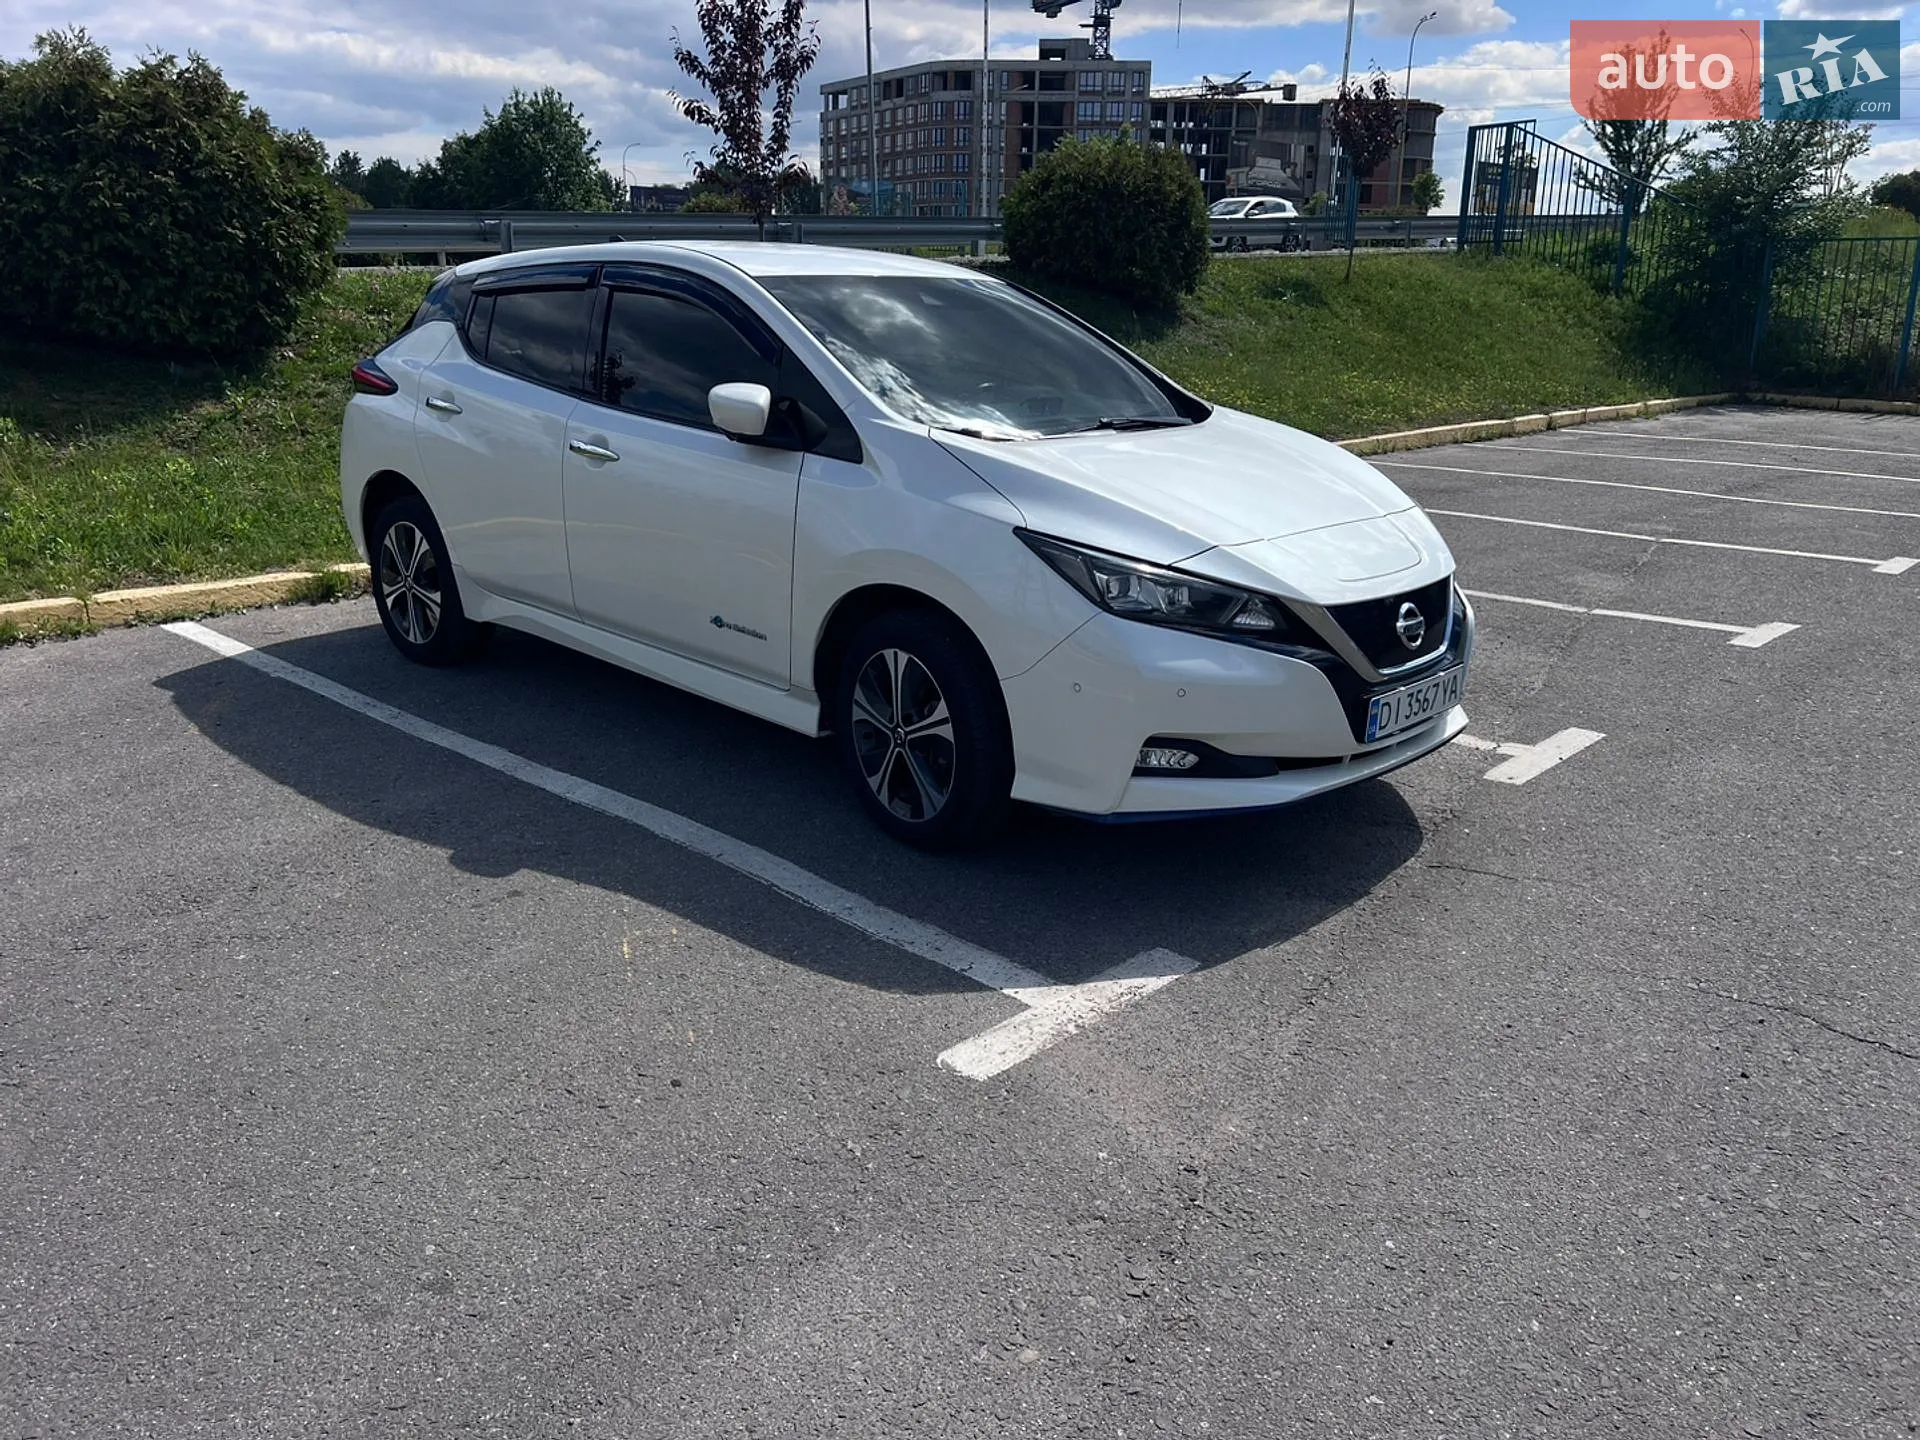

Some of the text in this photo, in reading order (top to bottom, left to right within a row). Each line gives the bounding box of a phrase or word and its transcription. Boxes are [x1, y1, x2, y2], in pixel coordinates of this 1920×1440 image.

[1378, 674, 1458, 731] DI 3567 YA
